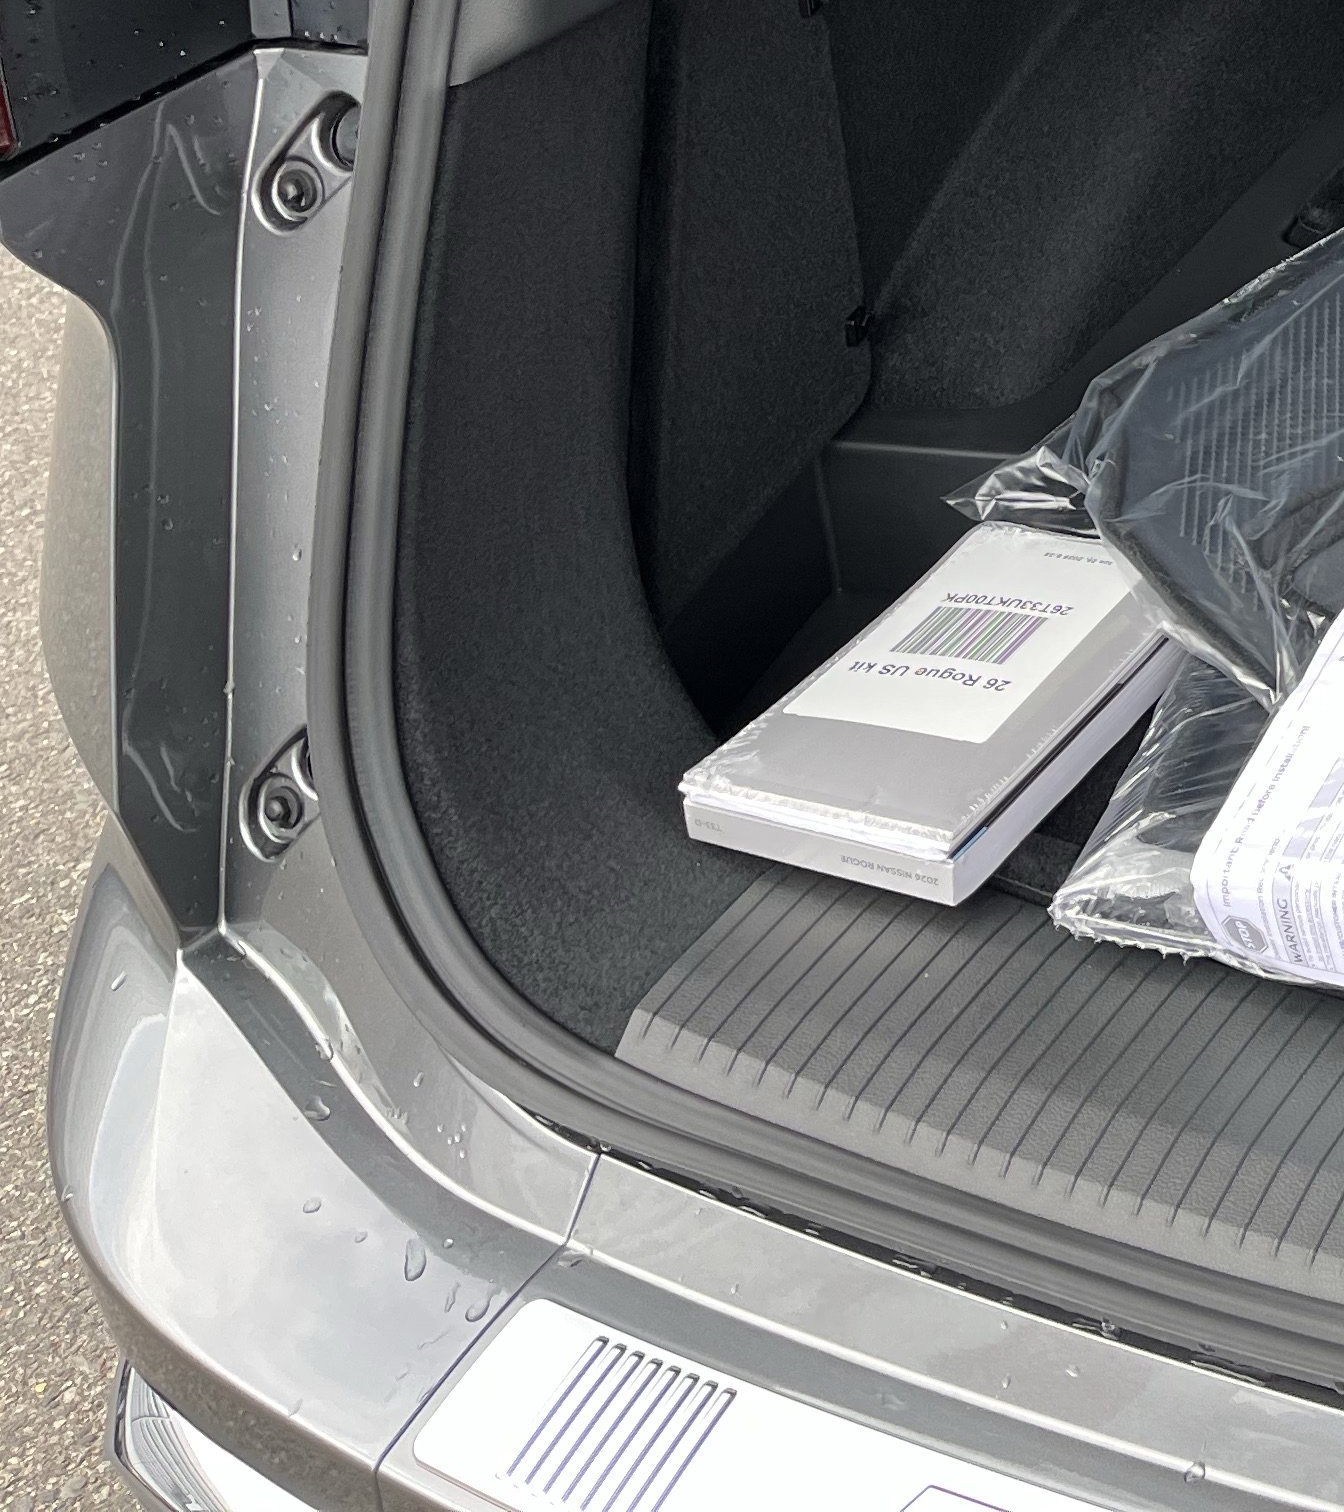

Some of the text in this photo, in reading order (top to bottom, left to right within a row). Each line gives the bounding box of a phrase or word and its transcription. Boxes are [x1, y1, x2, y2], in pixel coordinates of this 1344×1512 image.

[941, 592, 1075, 616] 26T33UKT00PK
[848, 660, 1012, 692] 26 Rogue US kit
[694, 818, 723, 833] T33-D
[1235, 817, 1255, 845] Rd
[840, 854, 940, 886] 2026 NISSAN ROGUE
[1234, 921, 1256, 950] STOP
[1276, 898, 1304, 963] WARNING
